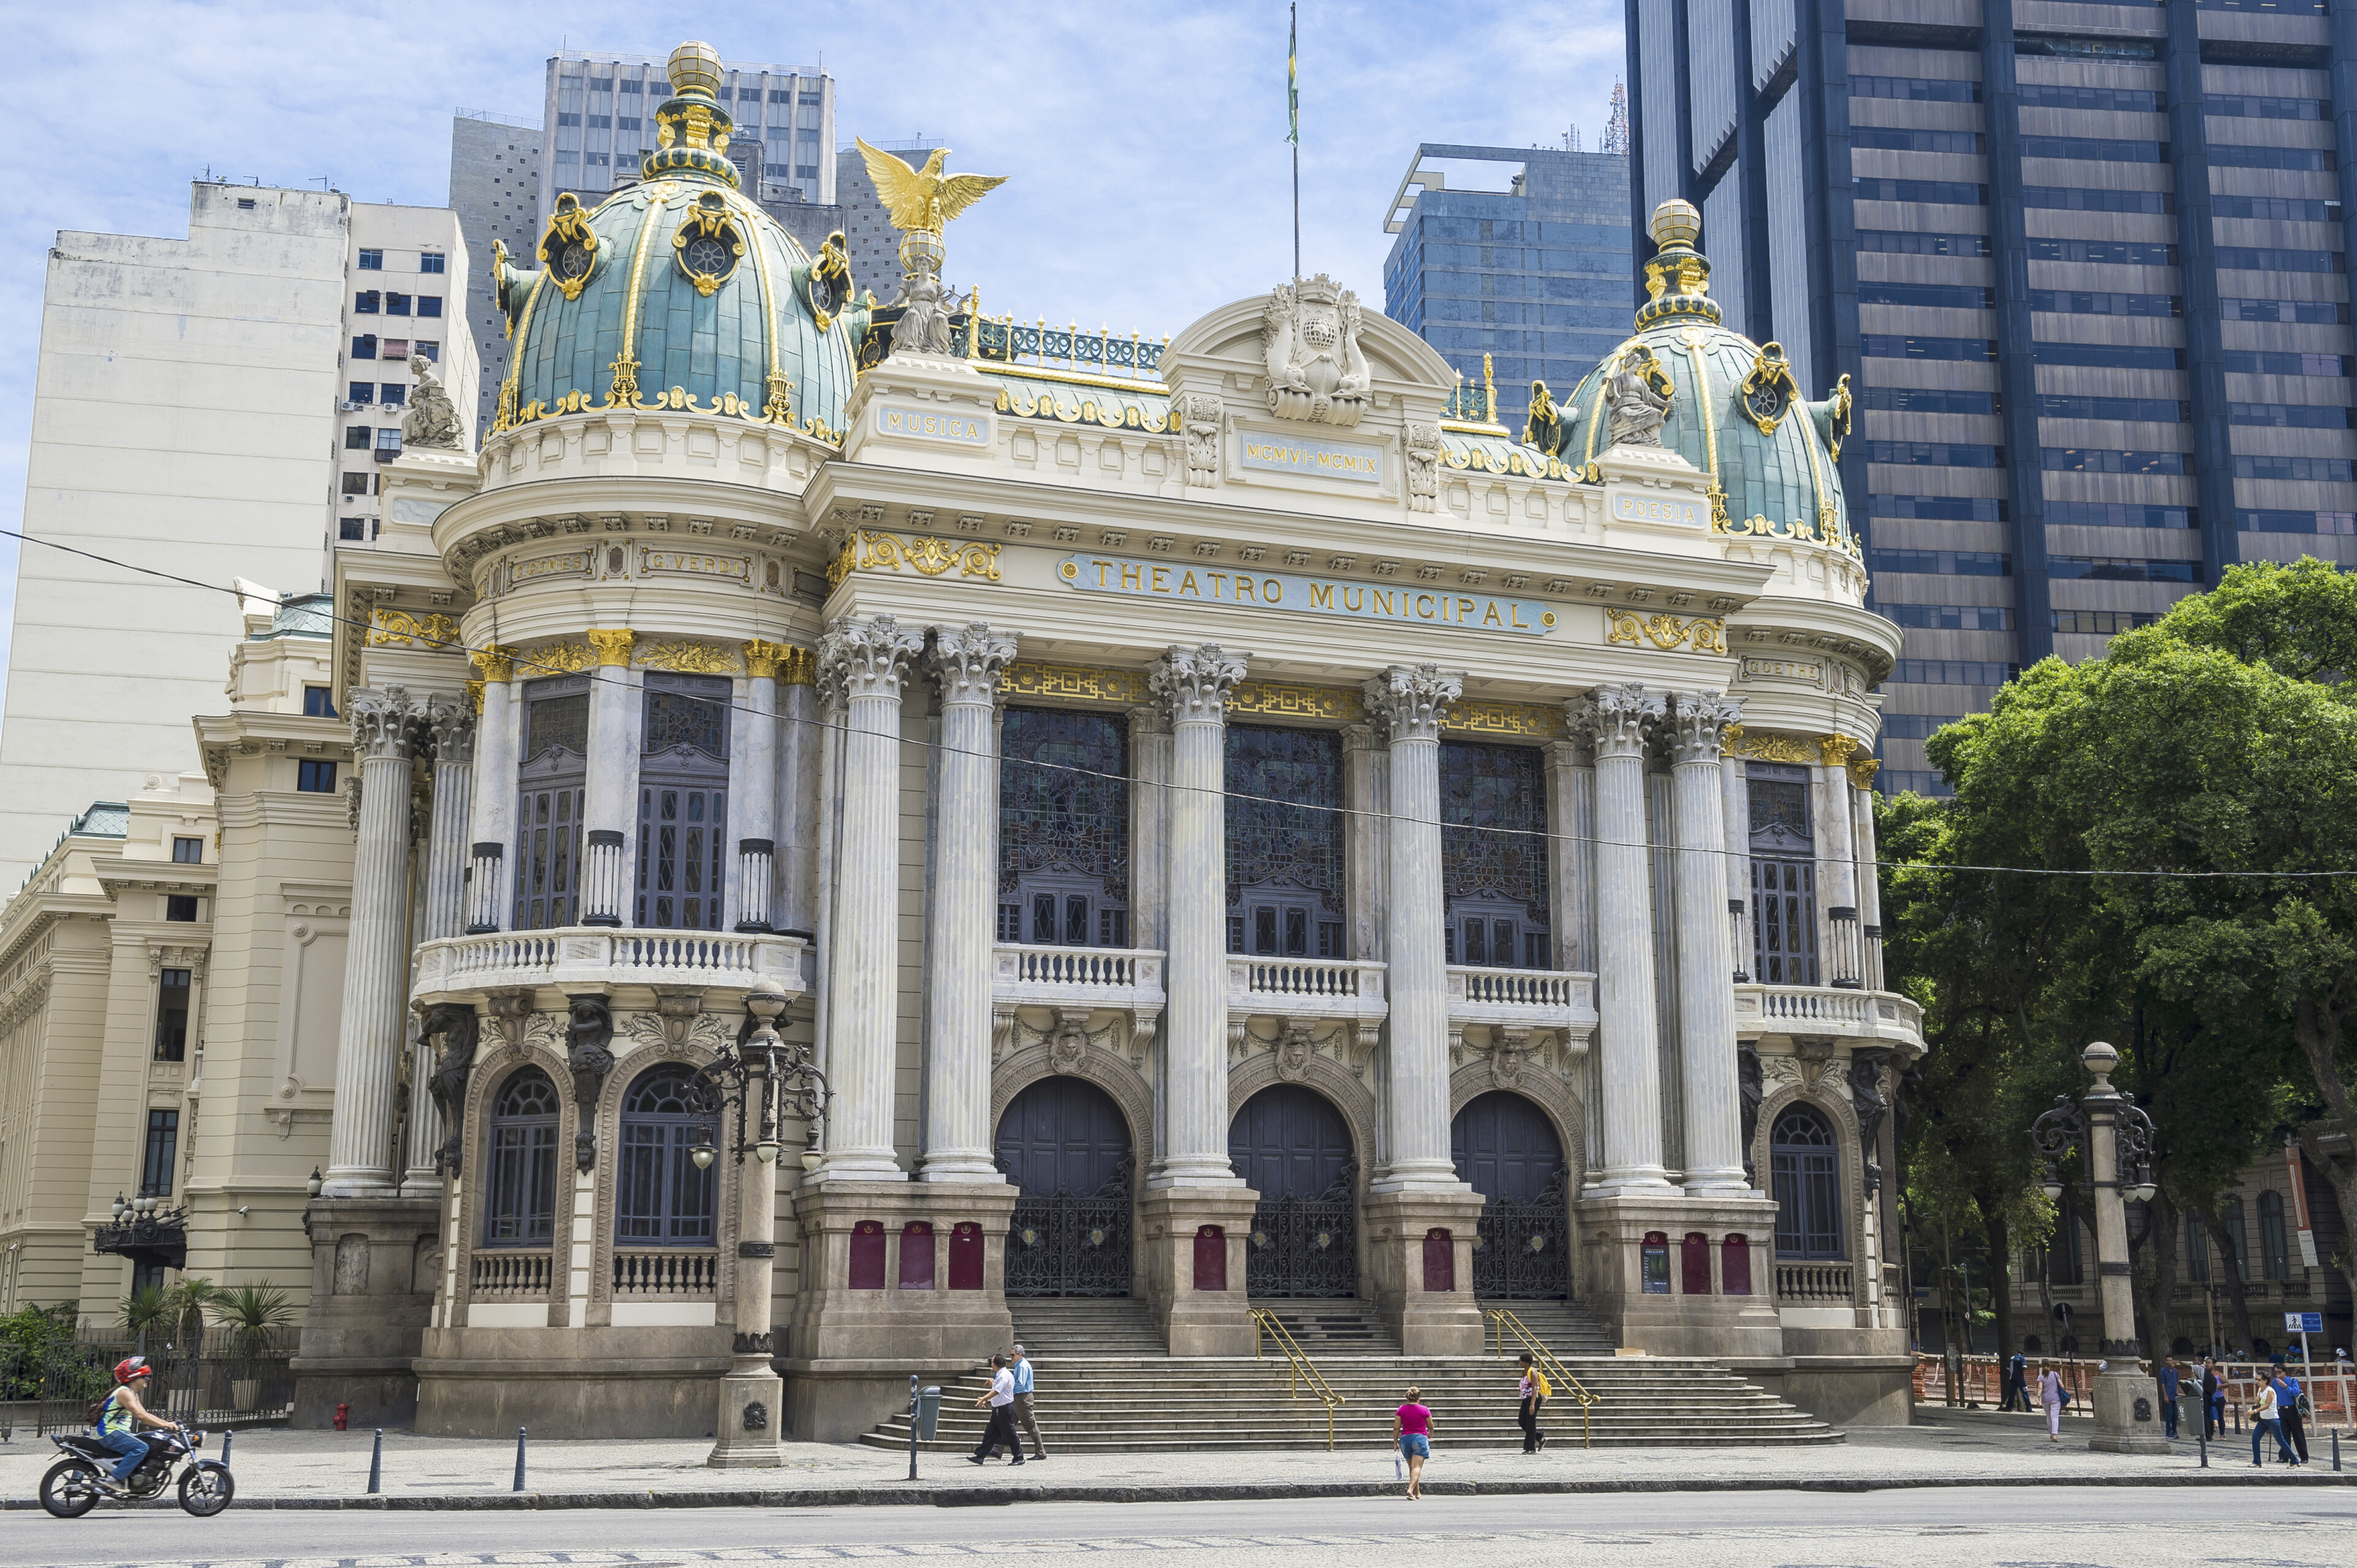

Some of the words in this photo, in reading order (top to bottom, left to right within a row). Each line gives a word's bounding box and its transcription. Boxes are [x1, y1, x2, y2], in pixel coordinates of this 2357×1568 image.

[888, 412, 978, 439] MUSICA
[1624, 500, 1695, 522] POESIA
[1091, 559, 1283, 604] THEATRO
[1309, 582, 1530, 630] MUNICIPAL
[1749, 661, 1816, 679] GOETHE
